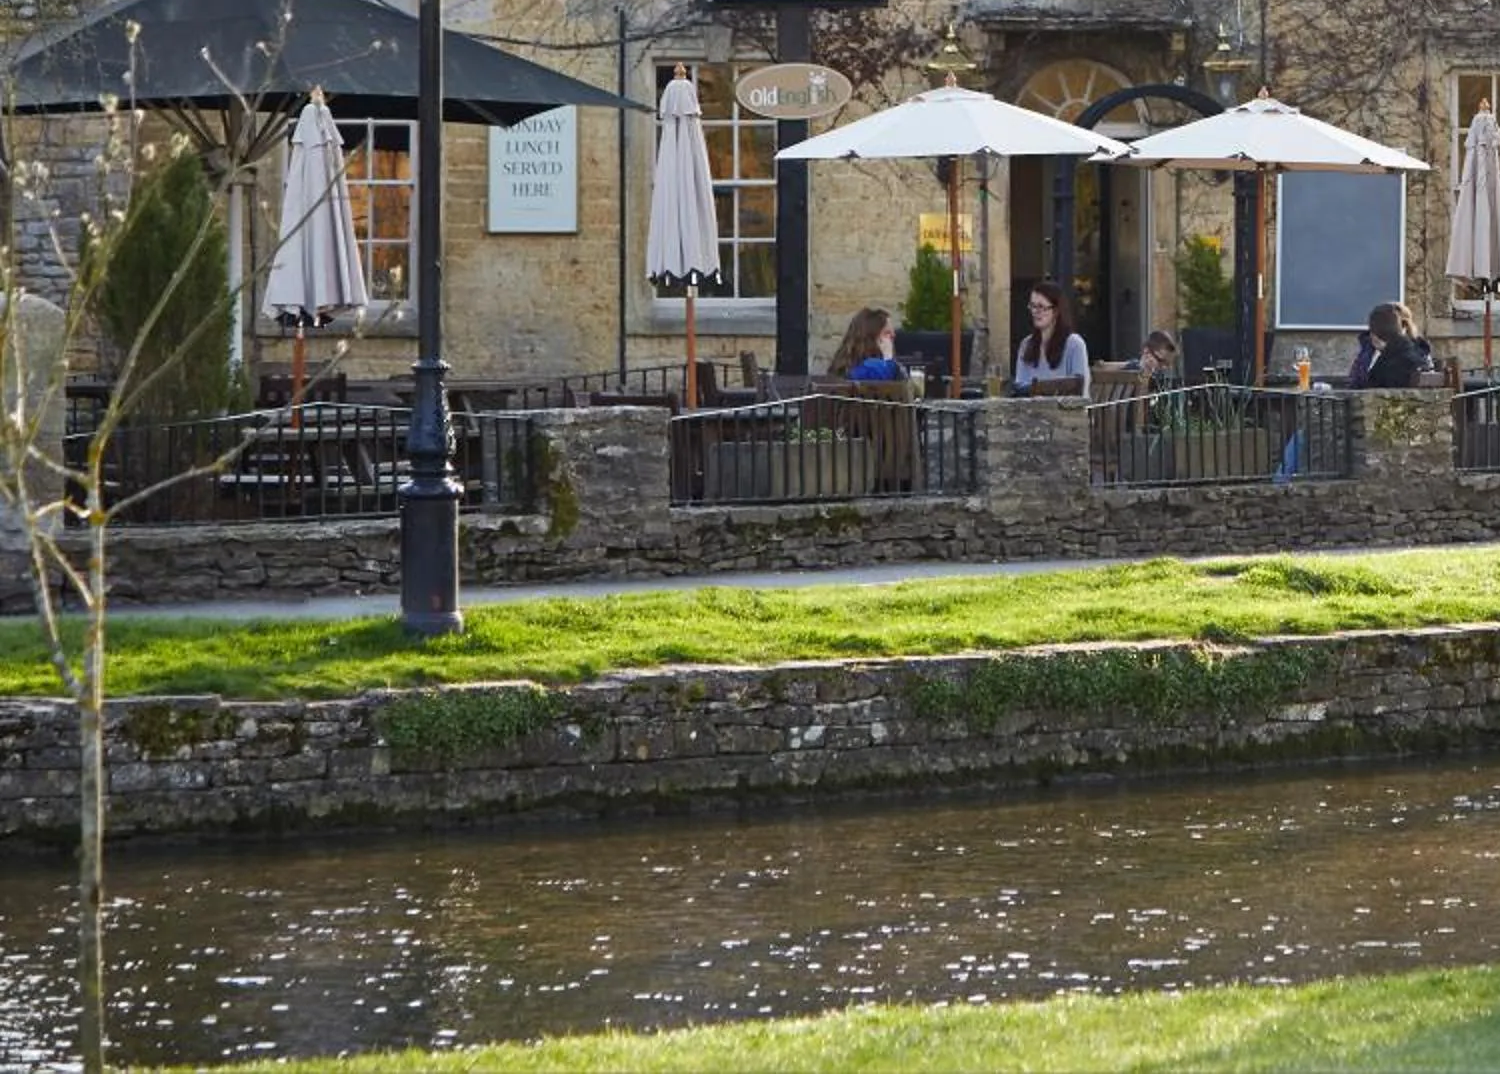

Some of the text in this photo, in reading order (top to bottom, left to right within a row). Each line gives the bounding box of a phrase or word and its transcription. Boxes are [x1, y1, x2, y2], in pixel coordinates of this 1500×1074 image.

[505, 140, 560, 155] LUNCH
[503, 161, 563, 176] SERVED
[512, 181, 553, 197] HERE
